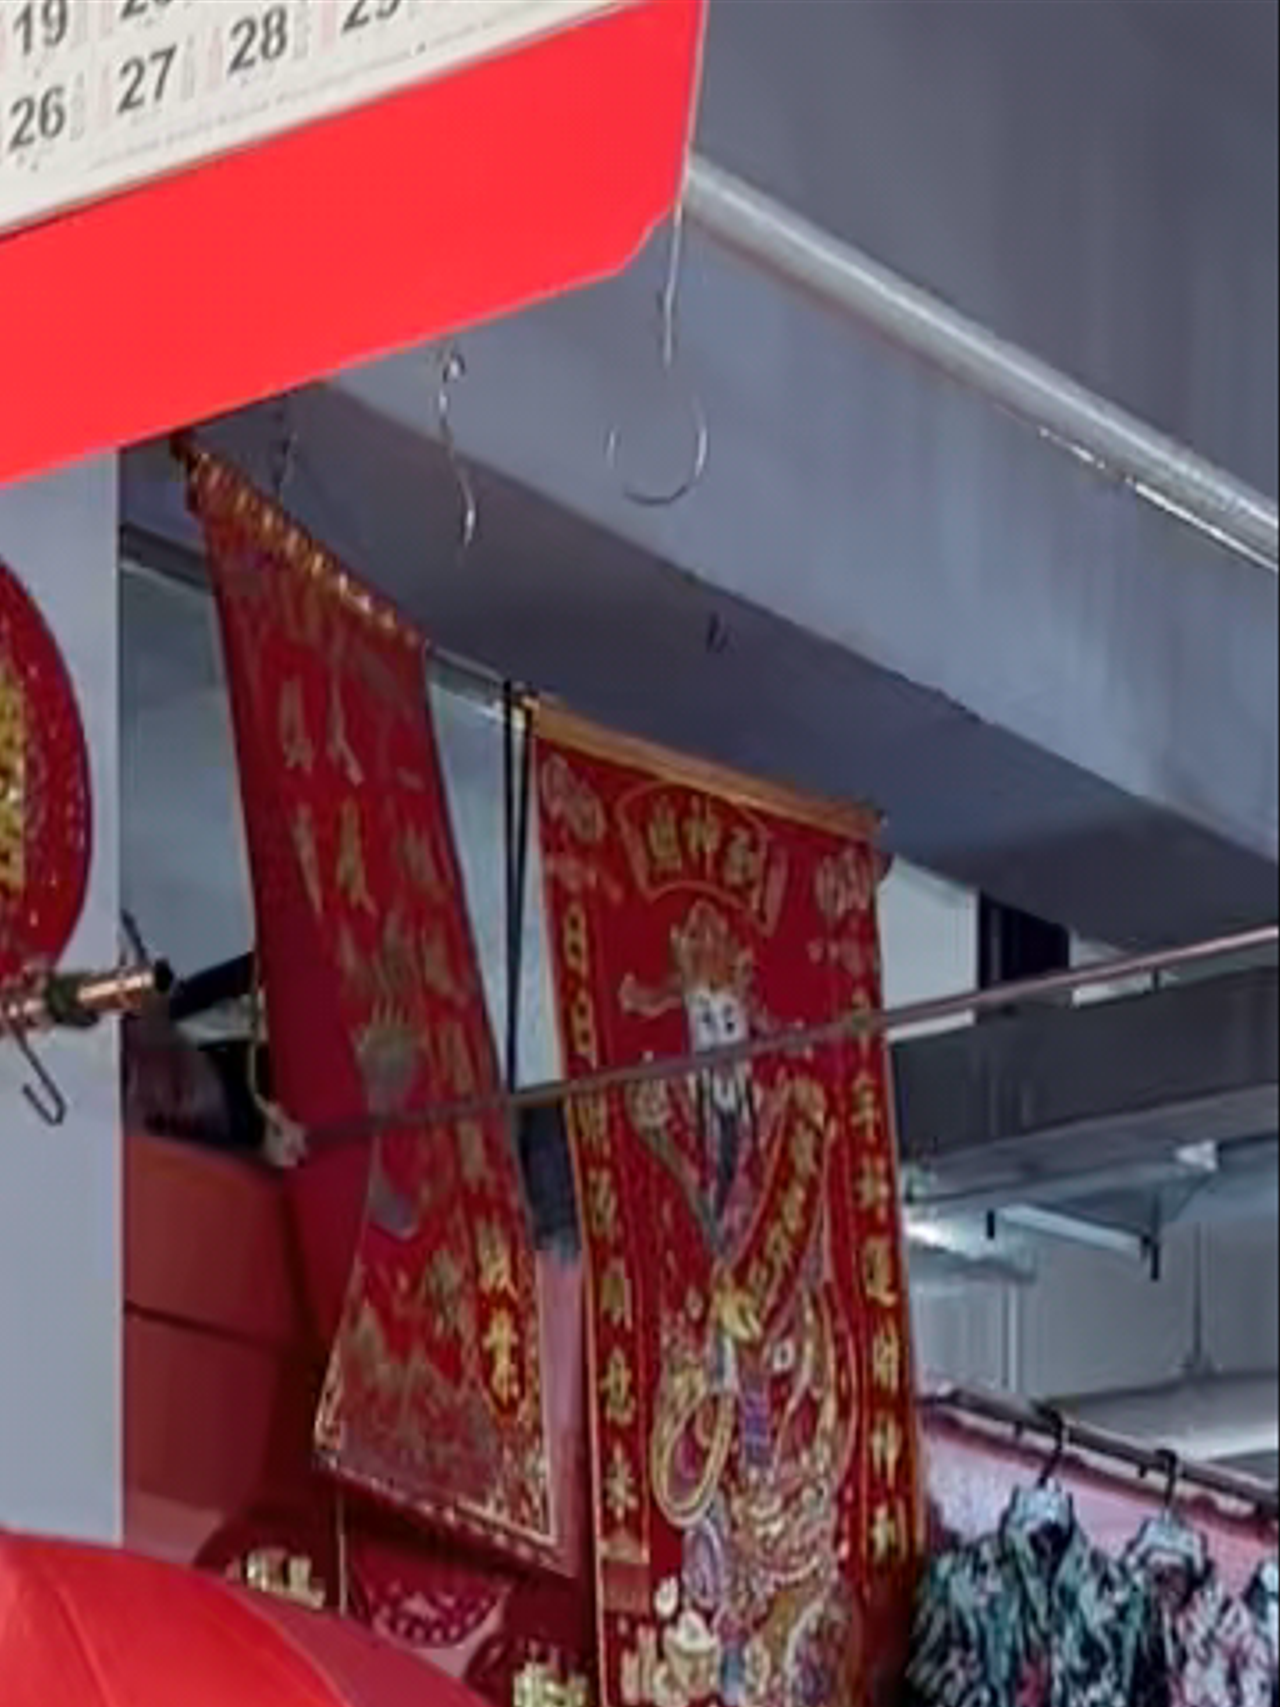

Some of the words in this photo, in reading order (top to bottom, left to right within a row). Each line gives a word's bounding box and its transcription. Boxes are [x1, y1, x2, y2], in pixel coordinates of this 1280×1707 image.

[14, 0, 68, 55] 19
[9, 86, 65, 152] 26
[117, 44, 177, 114] 27
[229, 6, 287, 74] 28
